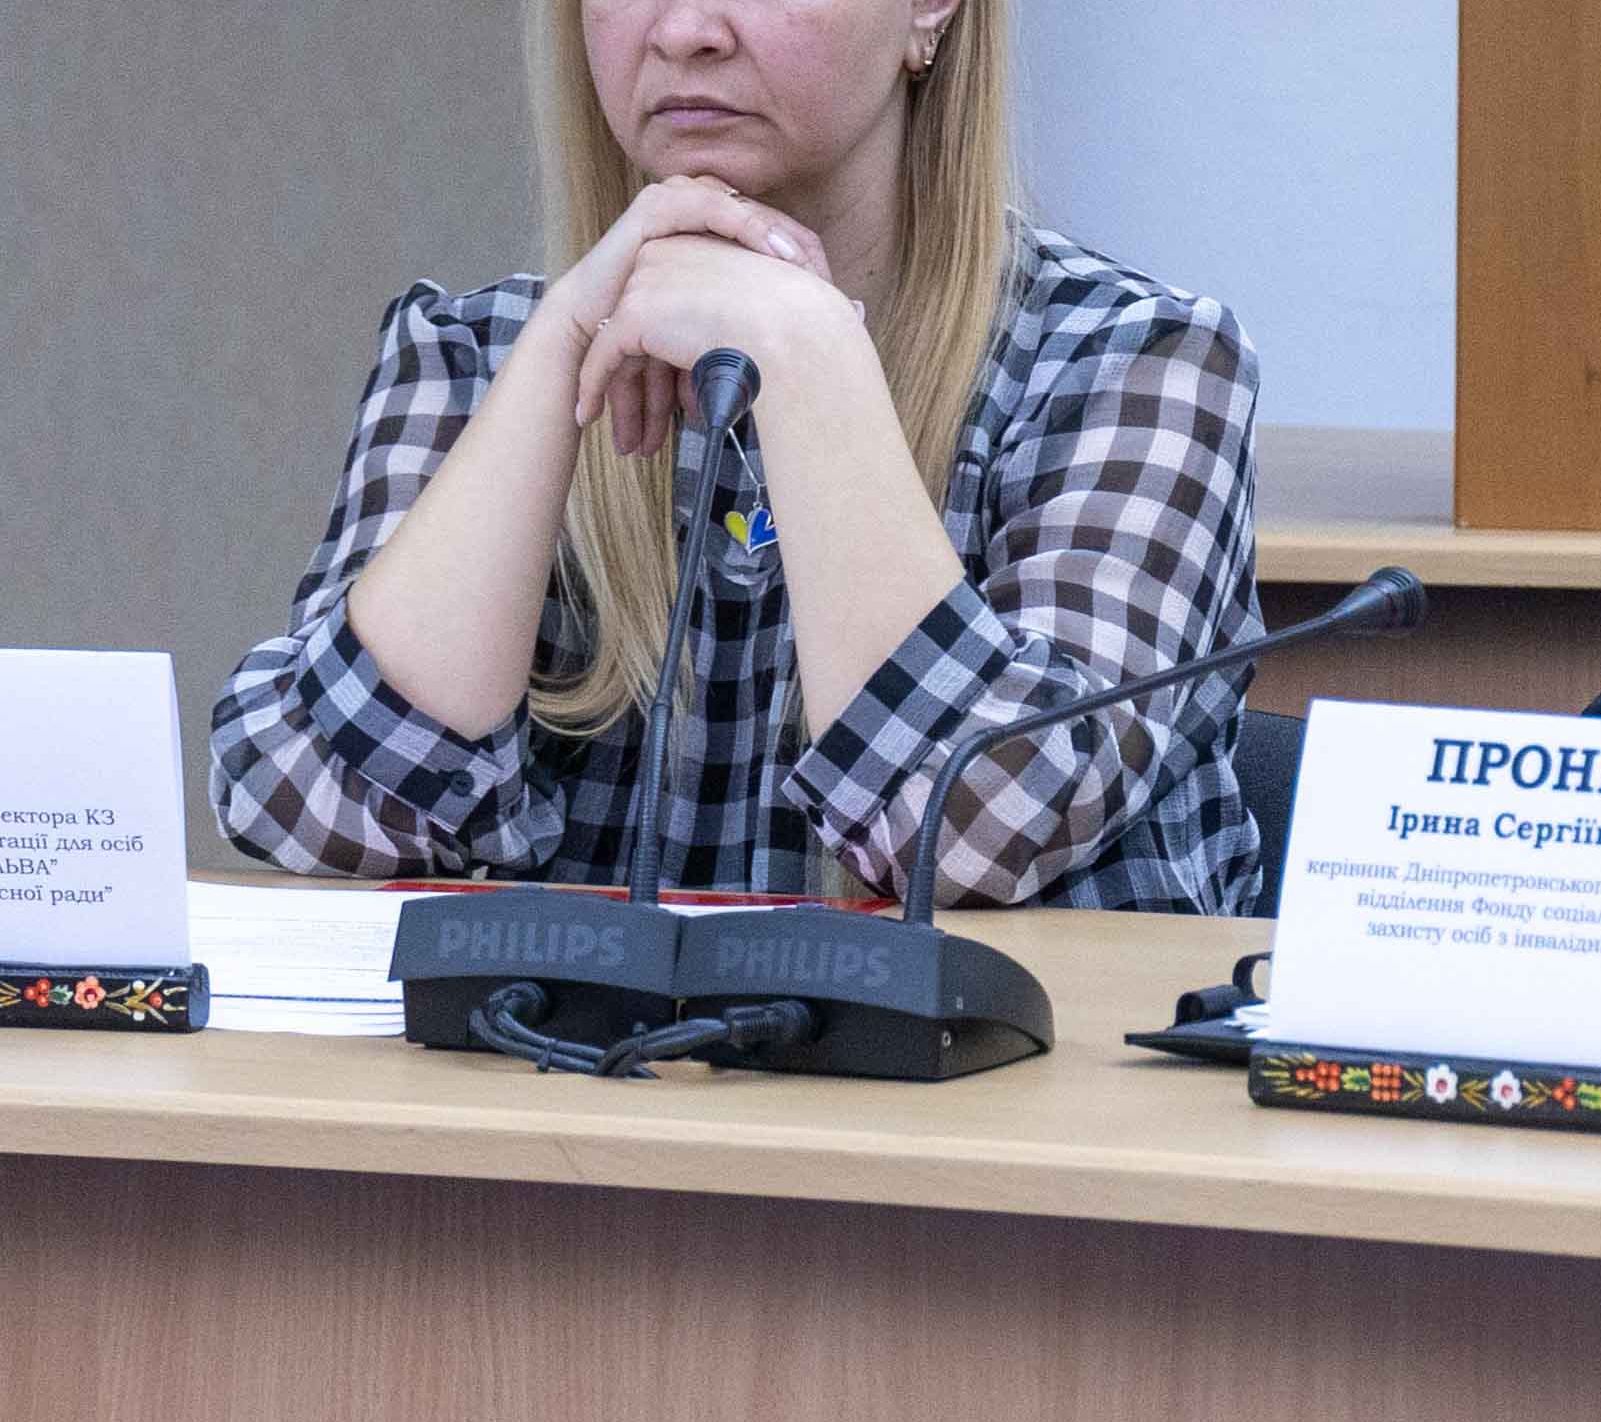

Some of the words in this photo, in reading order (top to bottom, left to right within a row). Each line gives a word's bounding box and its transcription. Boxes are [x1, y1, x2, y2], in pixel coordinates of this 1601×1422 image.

[85, 808, 116, 826] КЗ
[1388, 805, 1480, 839] Ірина
[56, 836, 93, 853] для
[101, 833, 144, 852] осіб
[1307, 858, 1398, 881] керівник
[1357, 890, 1465, 914] відділення
[1471, 897, 1536, 922] Фонду
[437, 920, 624, 966] PHILIPS
[1367, 921, 1446, 944] захисту
[1452, 926, 1491, 945] осіб
[1499, 932, 1508, 945] з
[714, 935, 890, 986] PHILIPS
